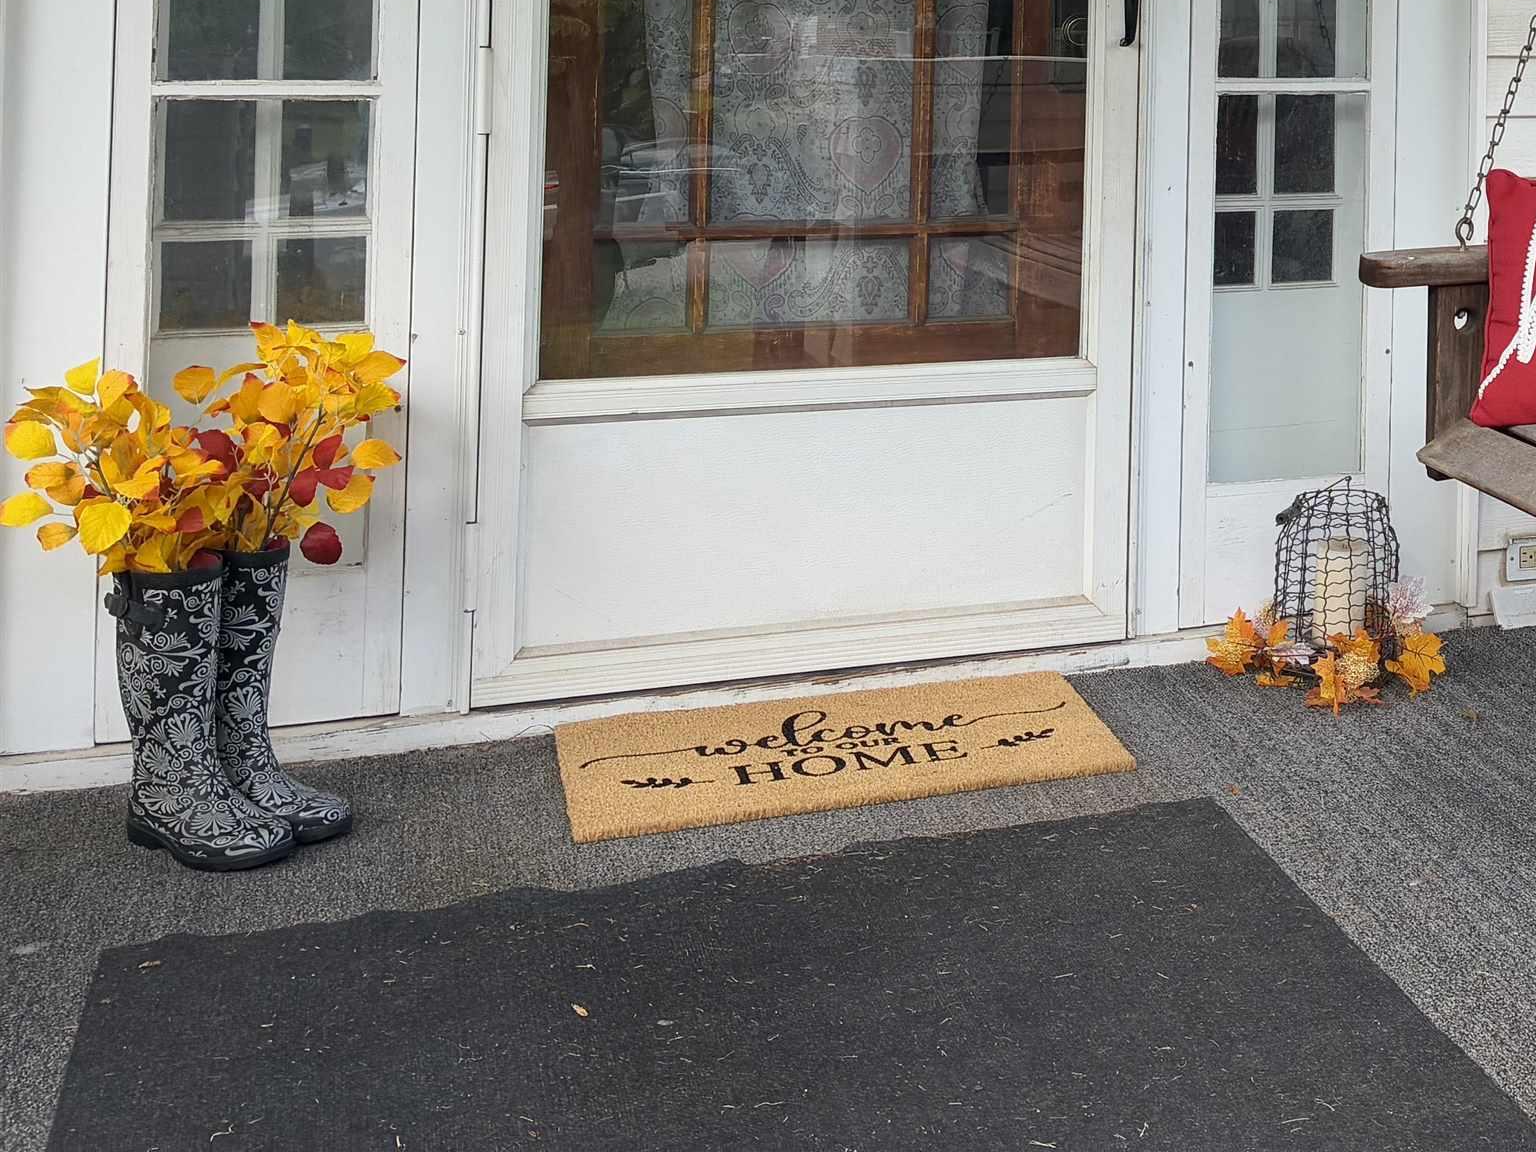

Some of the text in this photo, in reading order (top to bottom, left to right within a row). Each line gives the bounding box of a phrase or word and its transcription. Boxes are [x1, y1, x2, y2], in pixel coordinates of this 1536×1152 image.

[690, 709, 970, 757] welcome
[779, 736, 902, 757] TO OUR
[728, 740, 969, 786] HOME
